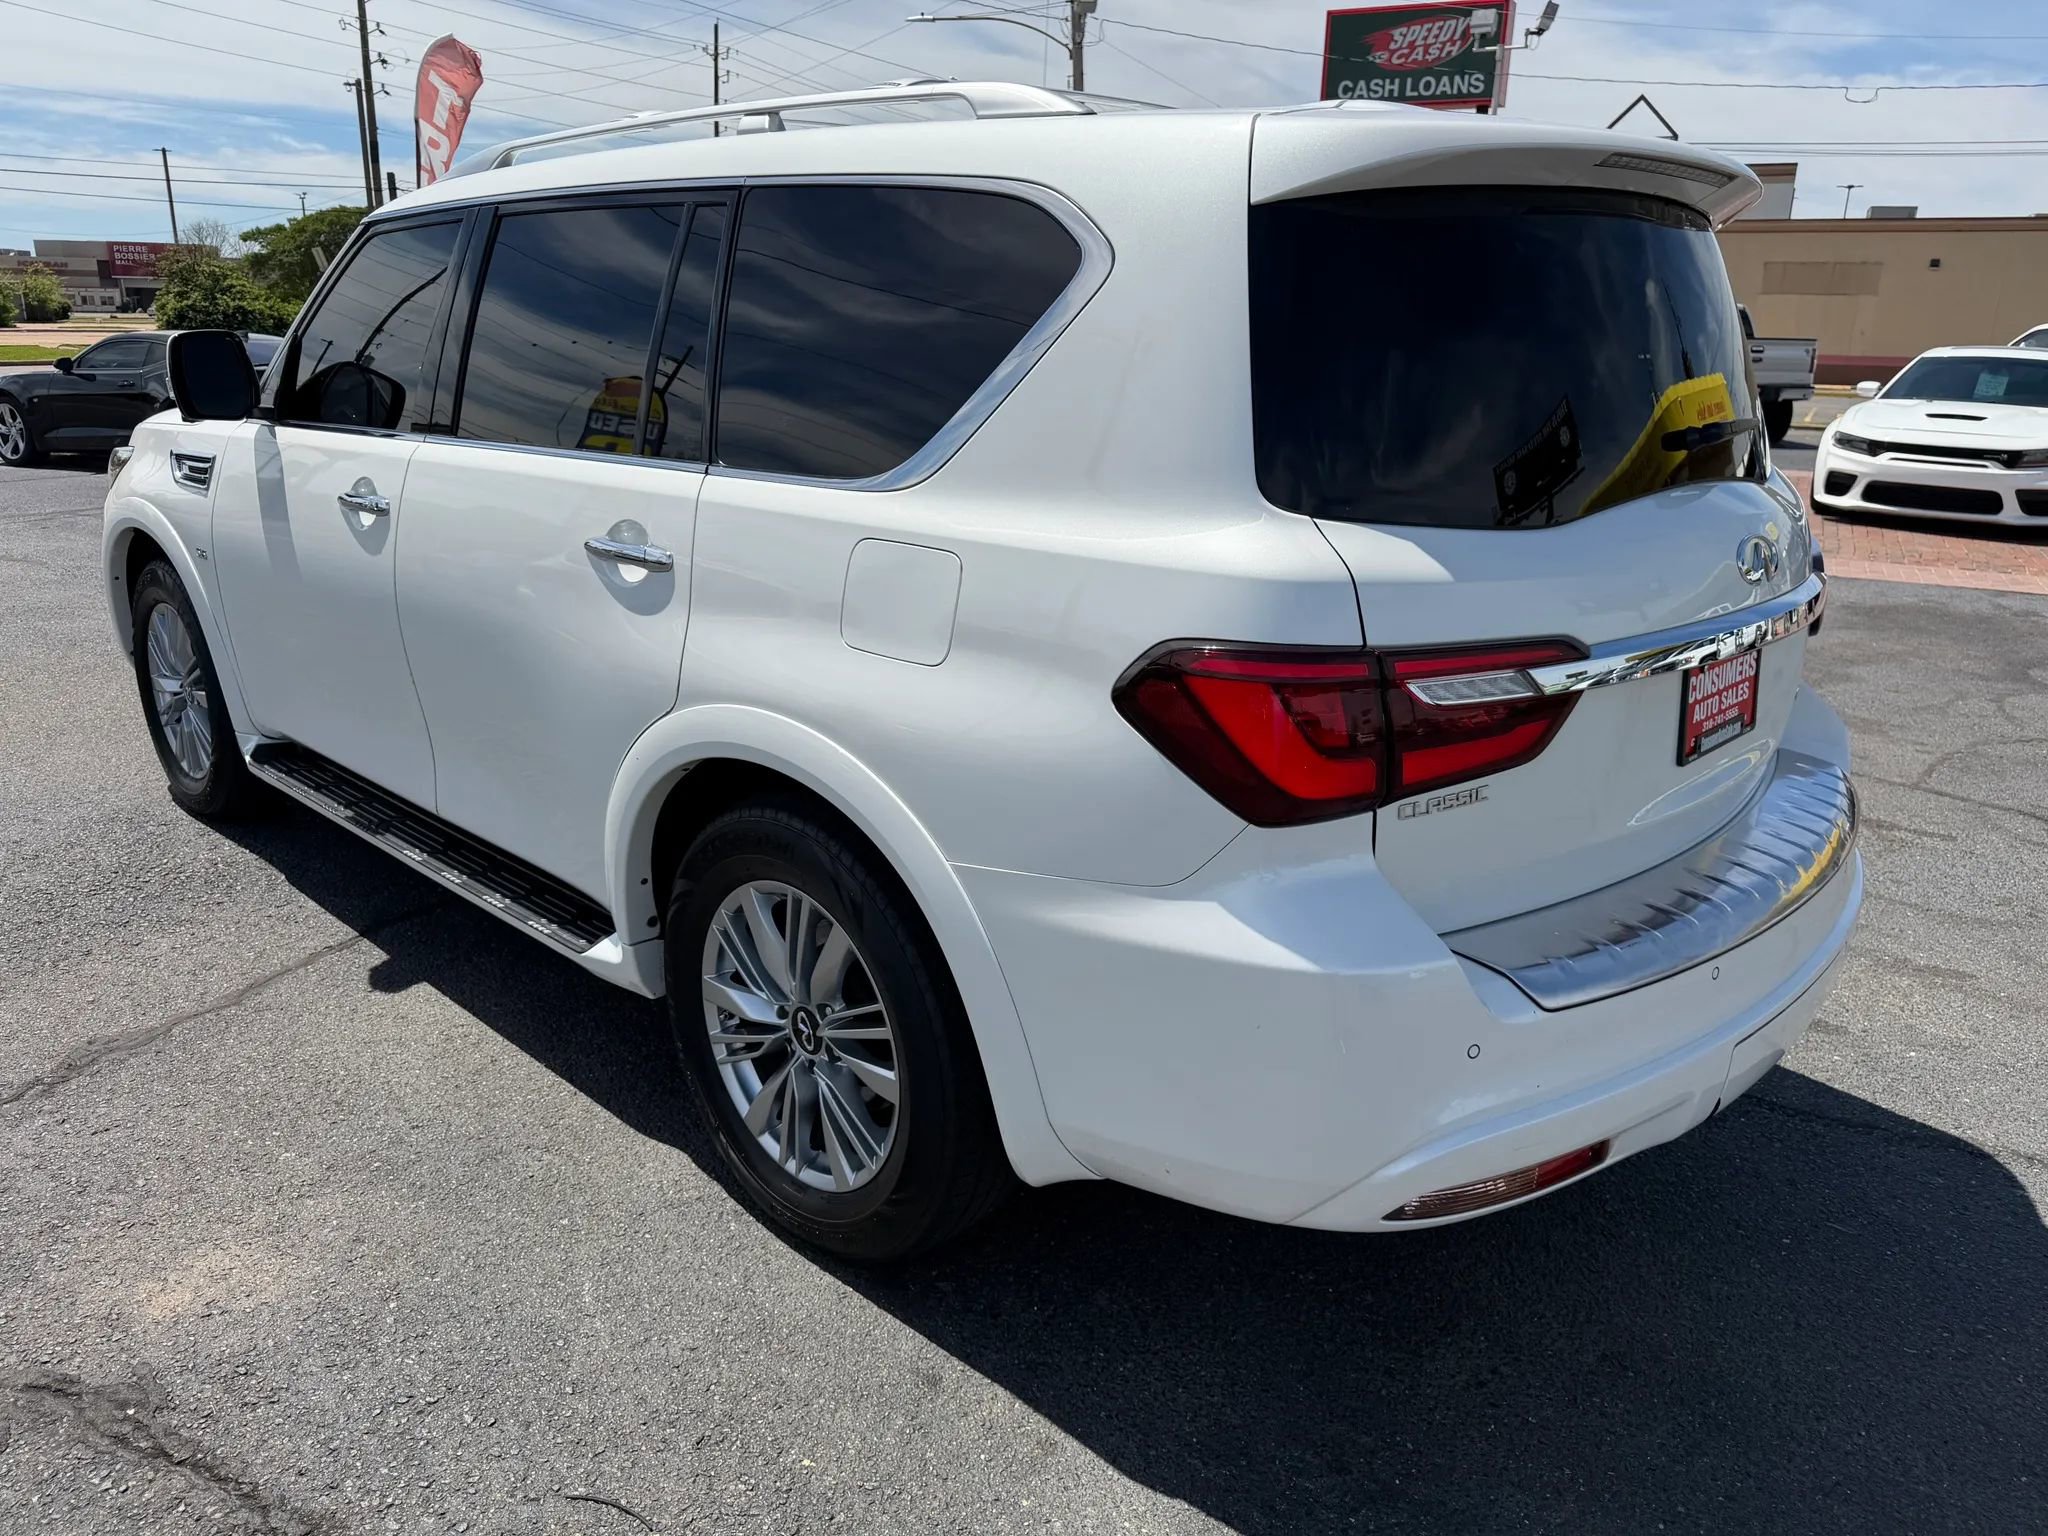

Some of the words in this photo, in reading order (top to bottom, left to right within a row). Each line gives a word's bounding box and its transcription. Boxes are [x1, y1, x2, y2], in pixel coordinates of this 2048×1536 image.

[1389, 17, 1473, 50] SPEEDY
[1337, 79, 1400, 99] CASH
[1405, 73, 1486, 97] LOANS
[113, 244, 149, 253] PIERRE
[114, 252, 156, 261] BOSSIER
[1688, 651, 1758, 704] CONSUMERS
[1692, 695, 1719, 724] AUTO
[1721, 681, 1750, 710] SALES
[1398, 784, 1489, 821] CLASSIC
